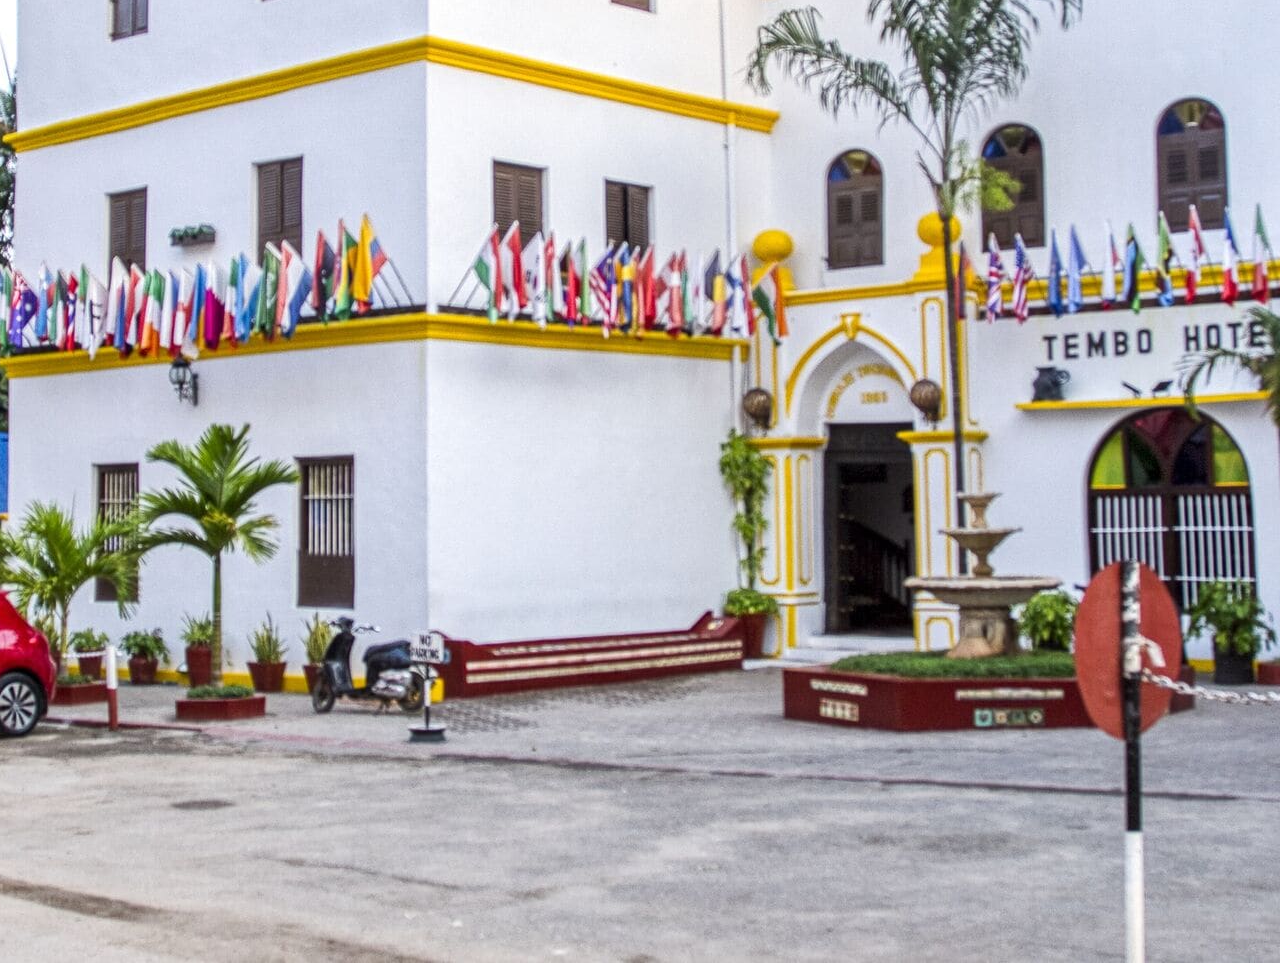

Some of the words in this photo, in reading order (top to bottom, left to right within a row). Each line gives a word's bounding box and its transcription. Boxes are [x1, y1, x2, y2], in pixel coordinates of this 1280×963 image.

[1042, 328, 1153, 361] TEMBO
[1184, 319, 1269, 351] HOTE
[419, 634, 432, 647] NO
[410, 647, 440, 660] PARKING
